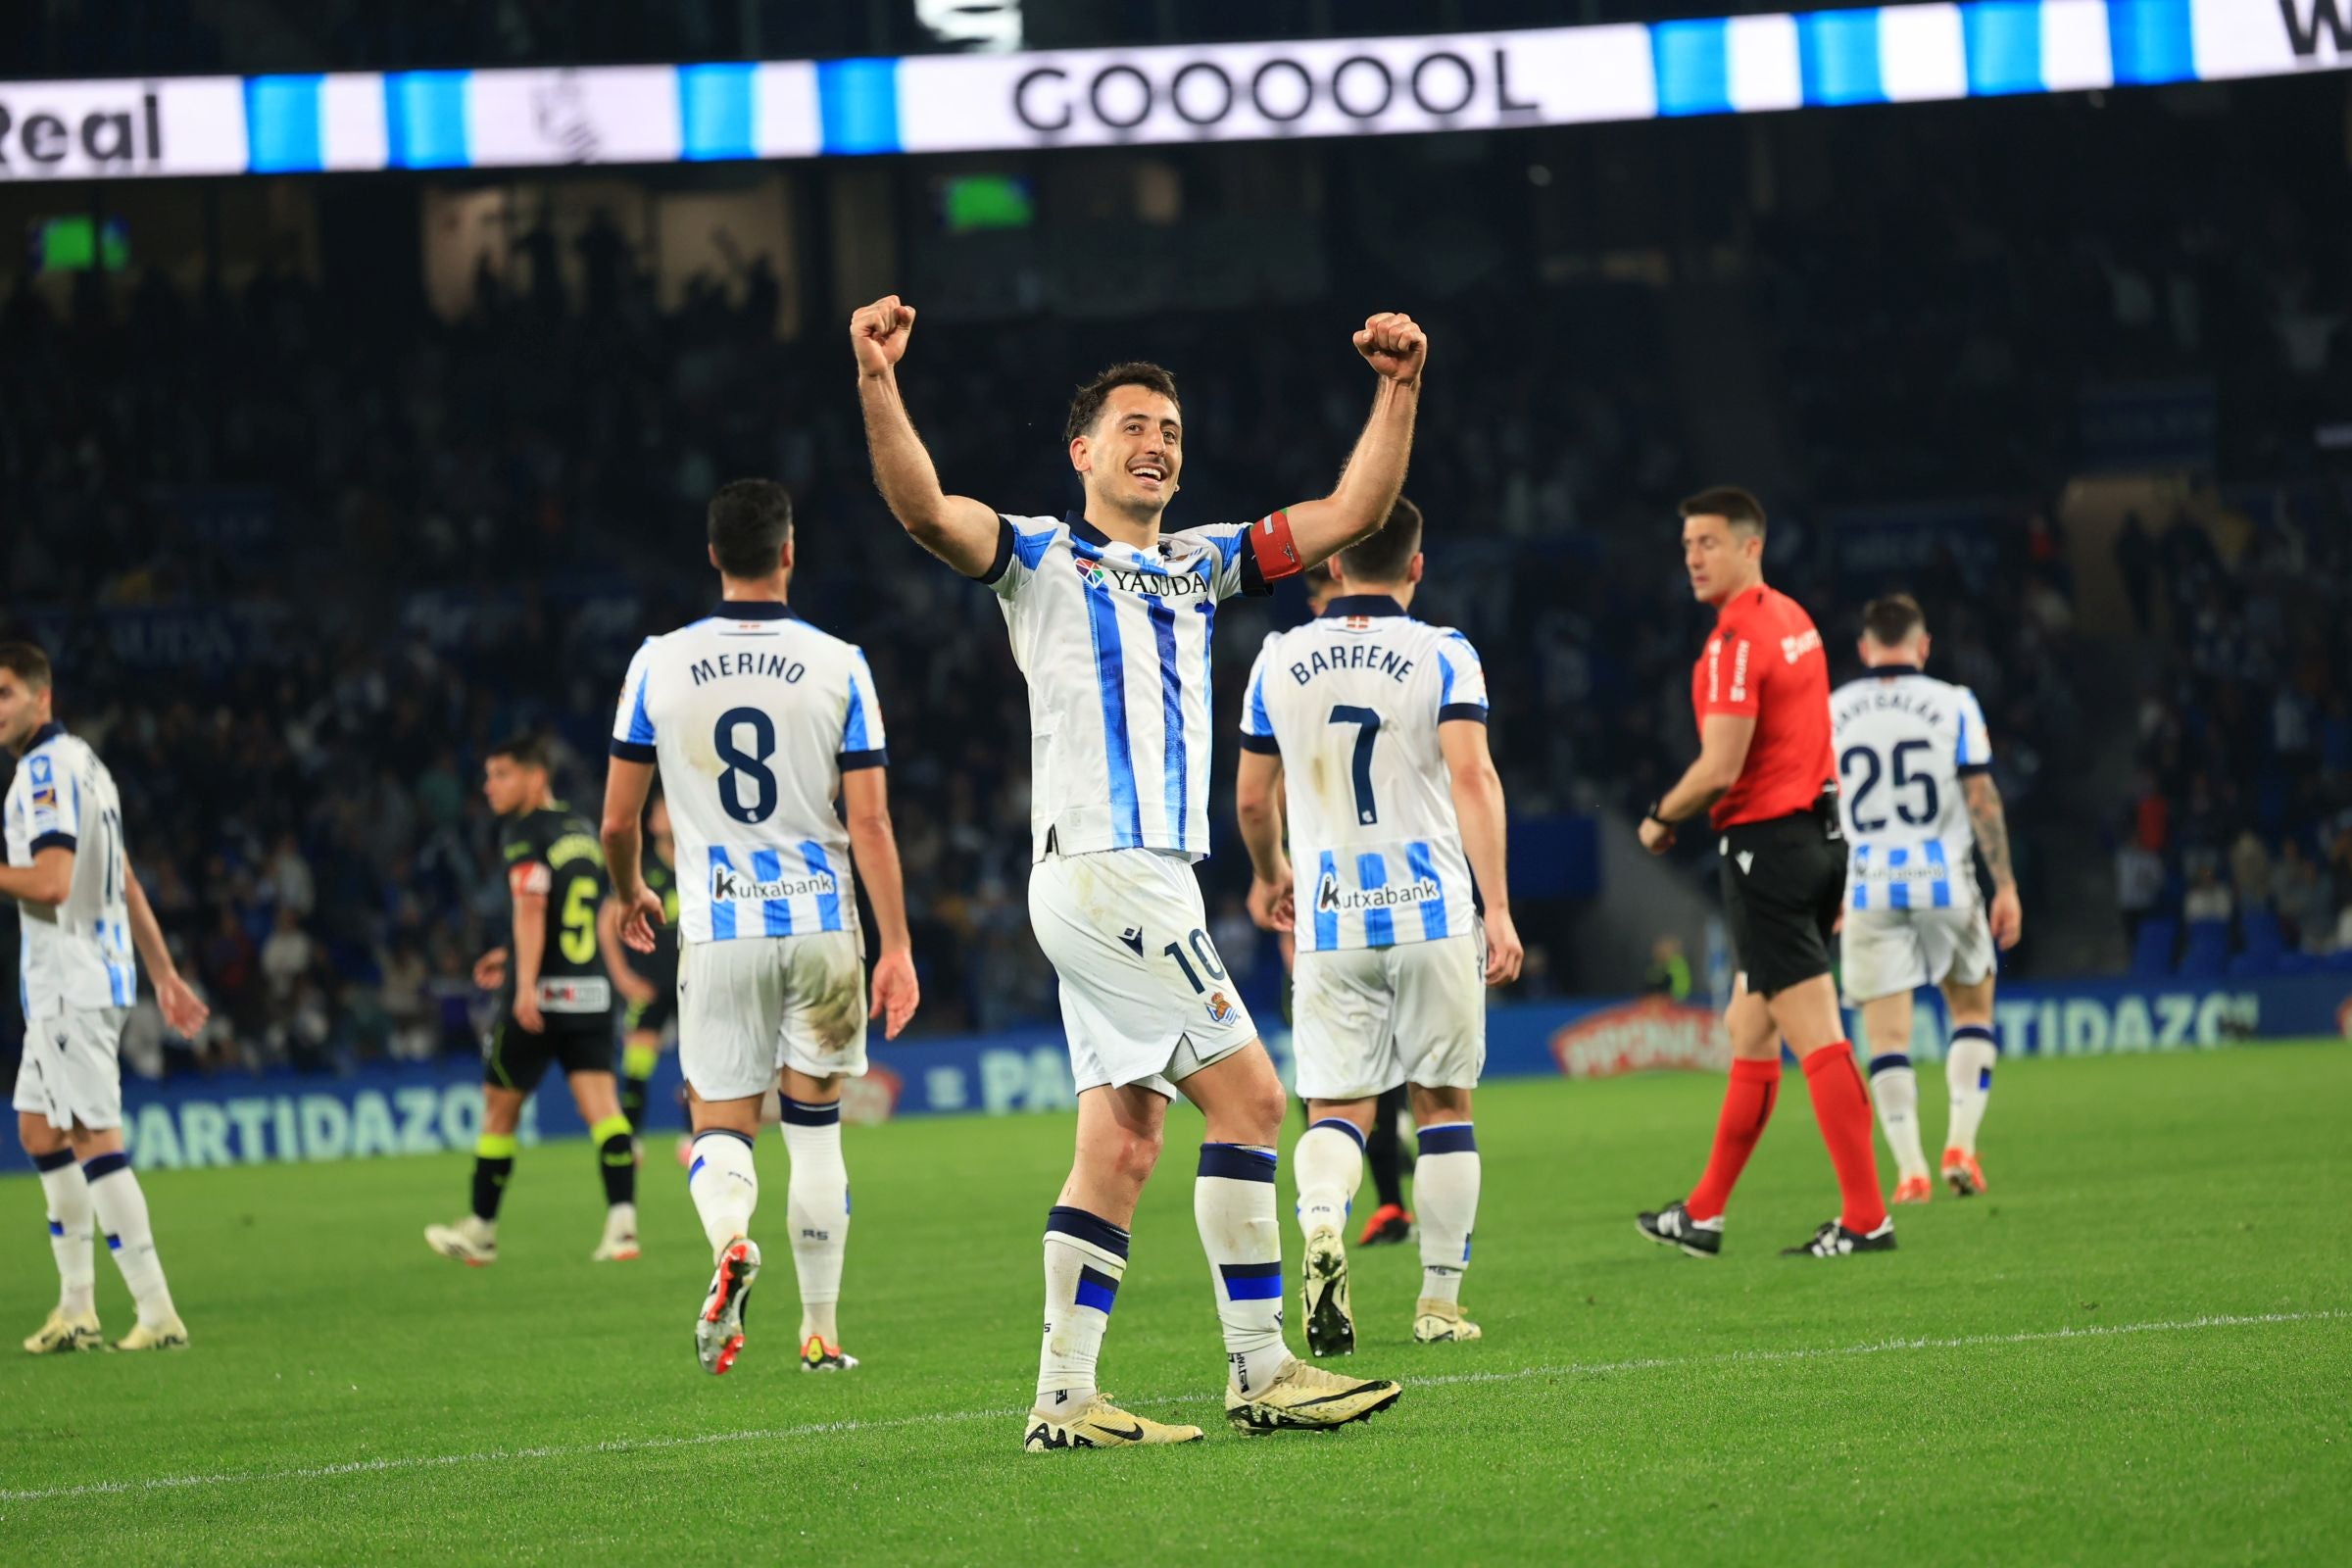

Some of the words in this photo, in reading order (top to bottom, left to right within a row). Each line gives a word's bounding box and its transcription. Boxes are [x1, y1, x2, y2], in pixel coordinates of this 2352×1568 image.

[1013, 48, 1541, 131] GOOOOOL
[0, 93, 160, 163] eal
[1109, 568, 1208, 597] YASUDA
[690, 652, 807, 687] MERINO
[1290, 645, 1414, 686] BARRENE
[713, 706, 778, 825] 8
[1328, 704, 1382, 826] 7
[1839, 739, 1939, 834] 25
[559, 875, 599, 965] 5
[1163, 928, 1226, 996] 10
